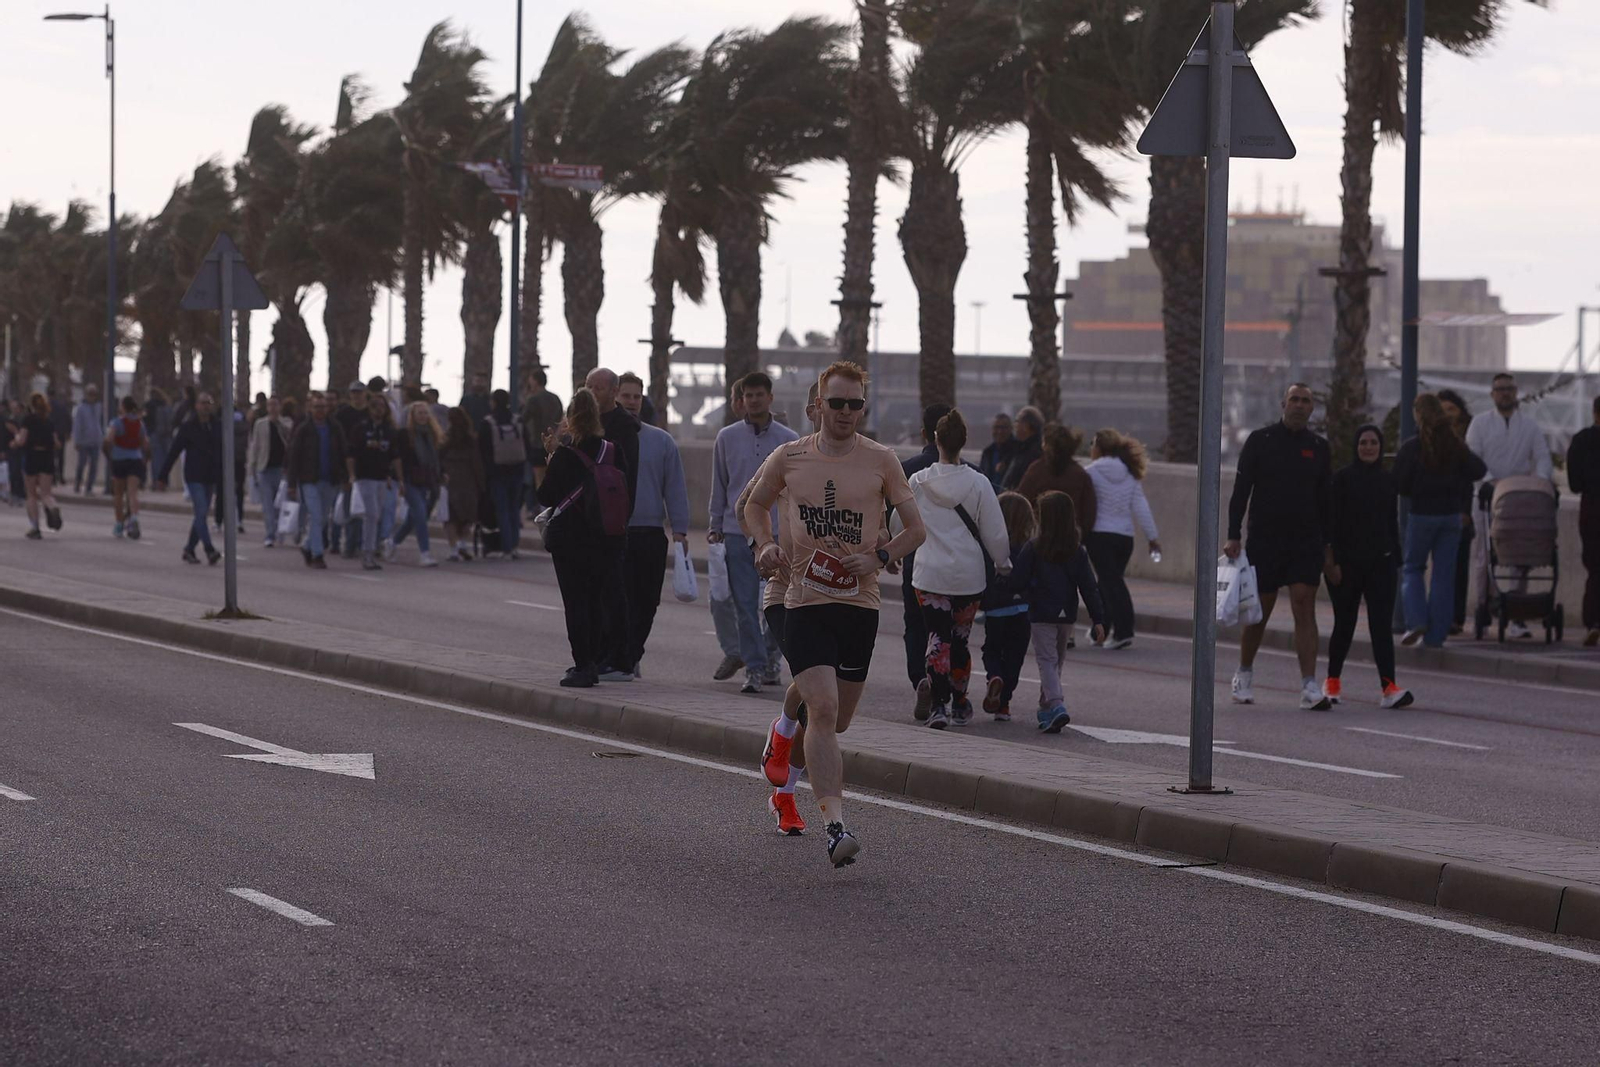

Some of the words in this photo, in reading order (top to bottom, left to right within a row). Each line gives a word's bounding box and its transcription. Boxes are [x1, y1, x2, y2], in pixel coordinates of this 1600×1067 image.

[798, 504, 863, 528] BRUNCH
[805, 520, 838, 539] RUN
[837, 533, 861, 545] 2025
[811, 562, 834, 577] BRUNCH
